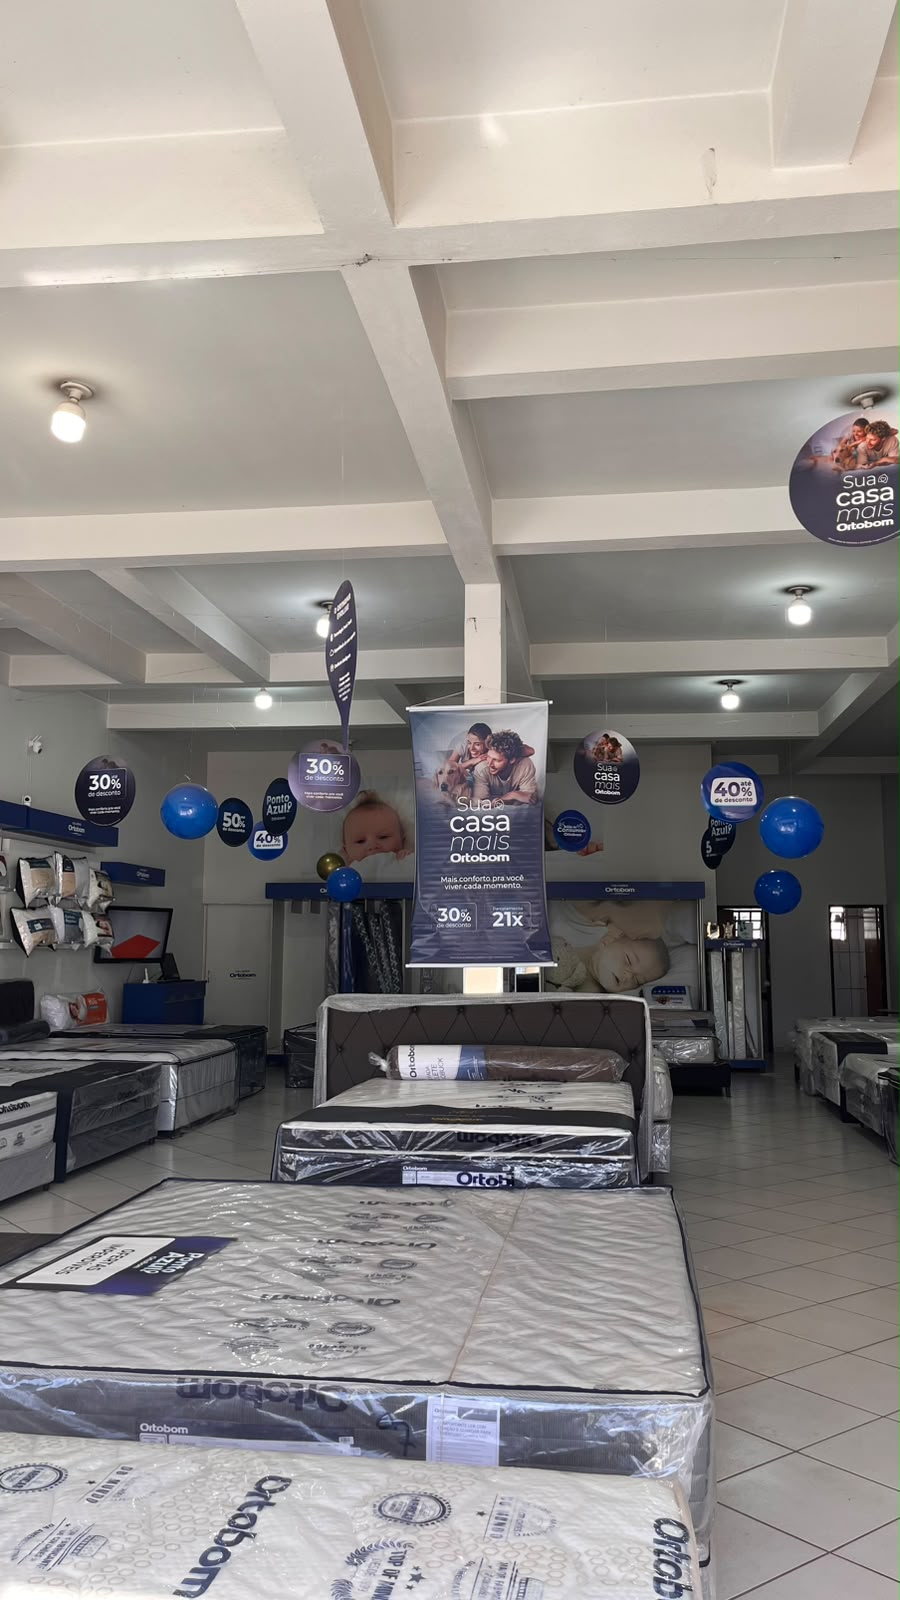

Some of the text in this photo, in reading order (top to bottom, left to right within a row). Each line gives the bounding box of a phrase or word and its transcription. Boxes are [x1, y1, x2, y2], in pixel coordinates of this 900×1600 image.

[843, 474, 876, 489] Sua
[836, 486, 894, 507] casa
[836, 502, 895, 523] mais
[836, 518, 895, 532] Ortobom
[306, 758, 344, 775] 30%
[597, 762, 613, 772] Sua
[89, 773, 122, 791] 30%
[594, 772, 620, 782] casa
[594, 781, 620, 790] mais
[714, 781, 753, 797] 40%
[266, 794, 290, 805] Ponto
[457, 796, 492, 812] Sua
[266, 803, 287, 816] Azul
[222, 811, 246, 828] 50%
[450, 814, 510, 833] casa
[450, 833, 510, 851] mais
[450, 852, 510, 863] Ortobom
[444, 882, 523, 890] viver cada momento.
[492, 875, 505, 883] pra
[506, 874, 524, 882] você
[437, 907, 472, 922] 30%
[492, 911, 524, 927] 21x
[407, 1045, 418, 1078] Ortobo
[86, 1248, 136, 1272] OFERTAS
[161, 1251, 205, 1274] Ponto
[176, 1377, 348, 1412] Ortobom
[139, 1422, 189, 1434] Ortobom
[86, 1479, 121, 1504] MUNDO
[172, 1475, 292, 1599] Ortobom
[653, 1518, 693, 1600] Ortob
[370, 1549, 408, 1600] TOP OF MIN
